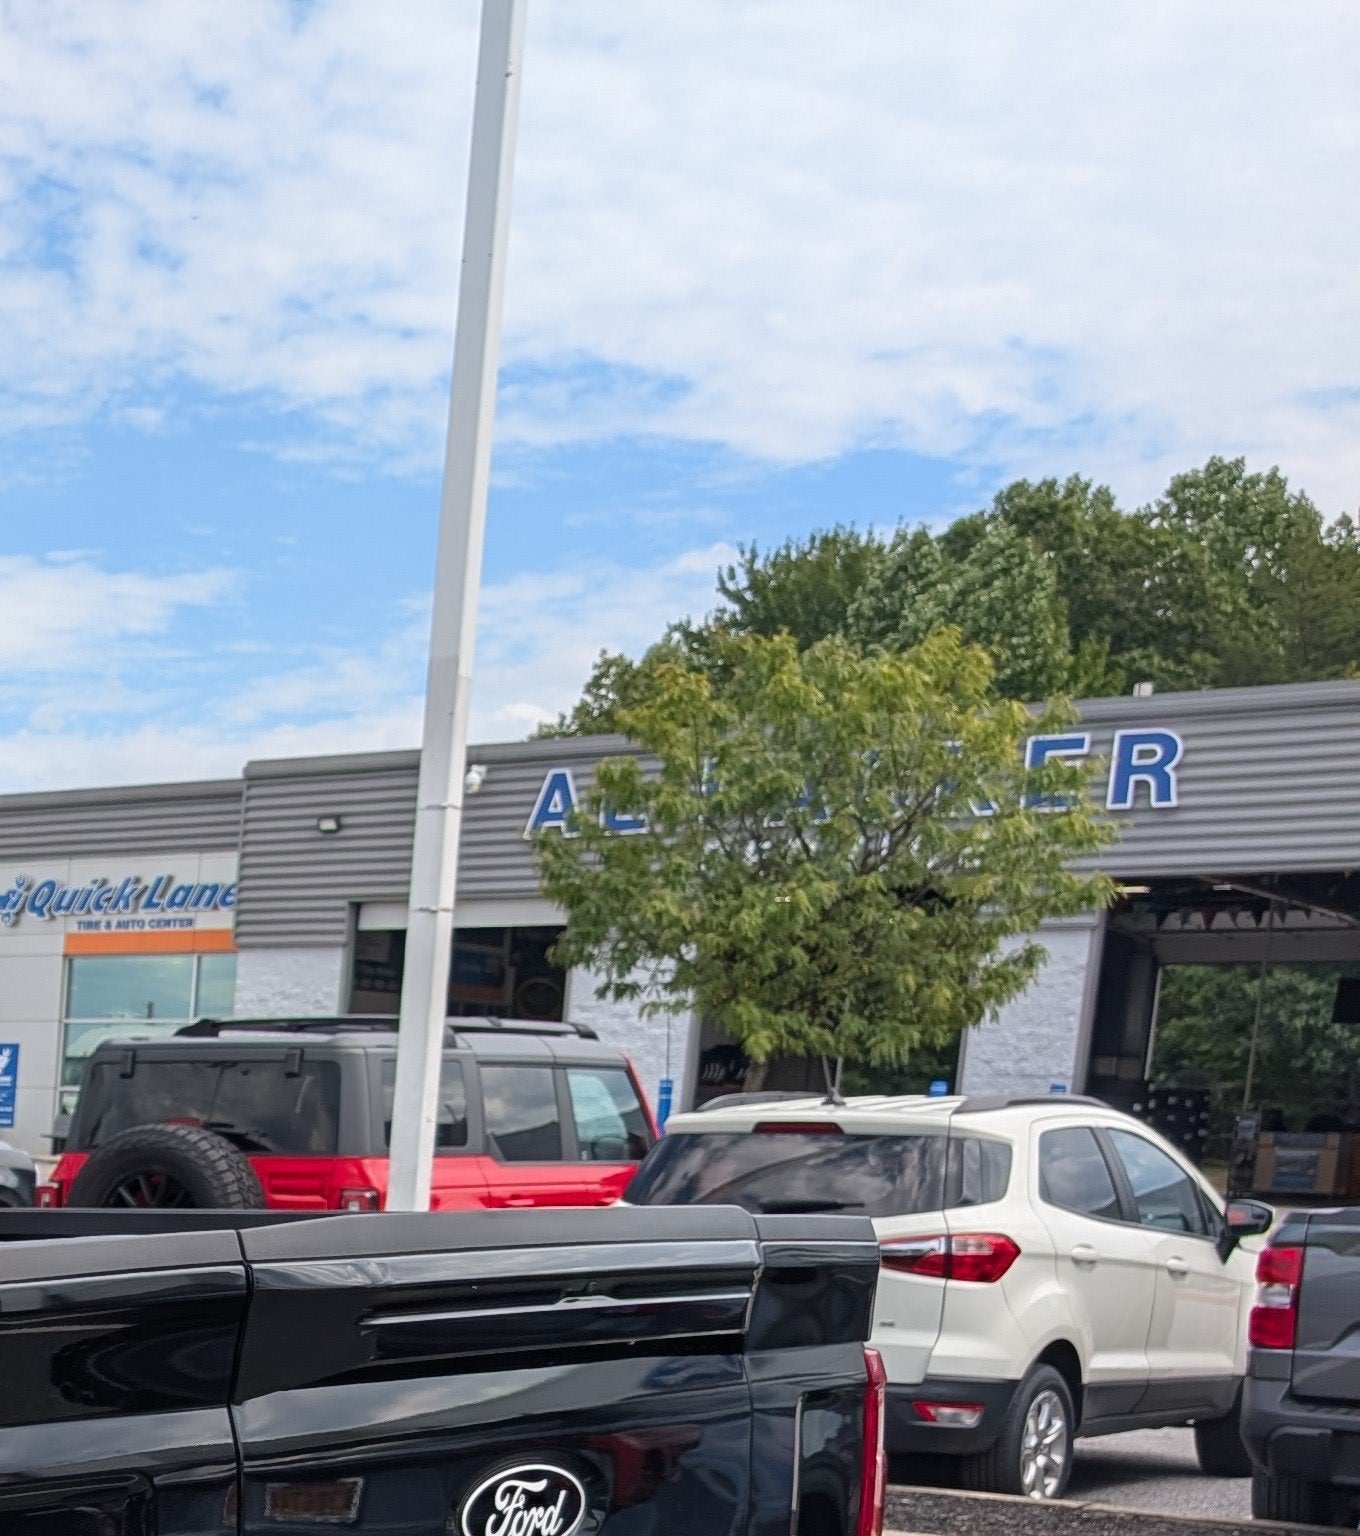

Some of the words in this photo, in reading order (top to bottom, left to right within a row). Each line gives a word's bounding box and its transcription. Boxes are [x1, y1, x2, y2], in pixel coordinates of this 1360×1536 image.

[27, 874, 148, 922] Quick
[140, 874, 237, 912] Lane
[77, 919, 102, 930] TIRE
[104, 919, 112, 929] &
[115, 918, 145, 929] AUTO
[147, 917, 194, 929] CENTER
